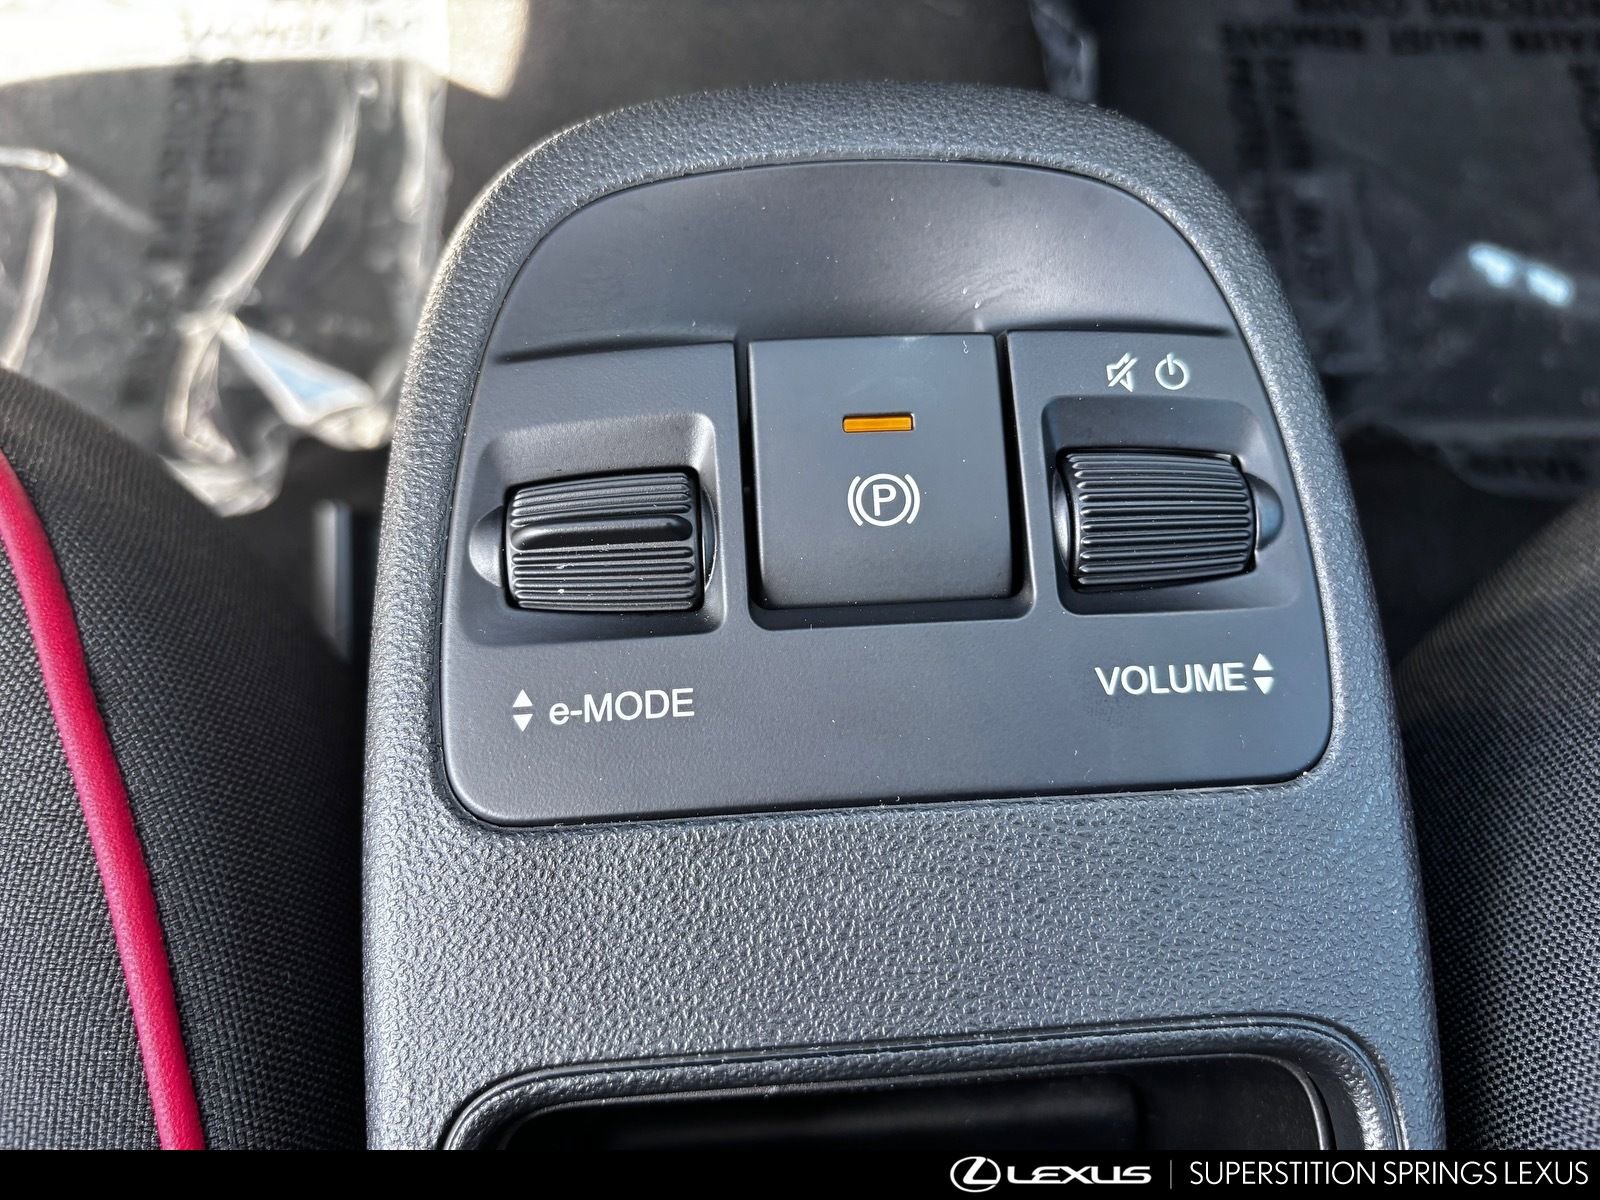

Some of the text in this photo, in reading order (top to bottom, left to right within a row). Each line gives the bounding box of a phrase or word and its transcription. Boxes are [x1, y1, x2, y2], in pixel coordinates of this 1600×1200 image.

[872, 483, 897, 517] P
[1094, 662, 1248, 696] VOLUME
[549, 687, 695, 726] e-MODE
